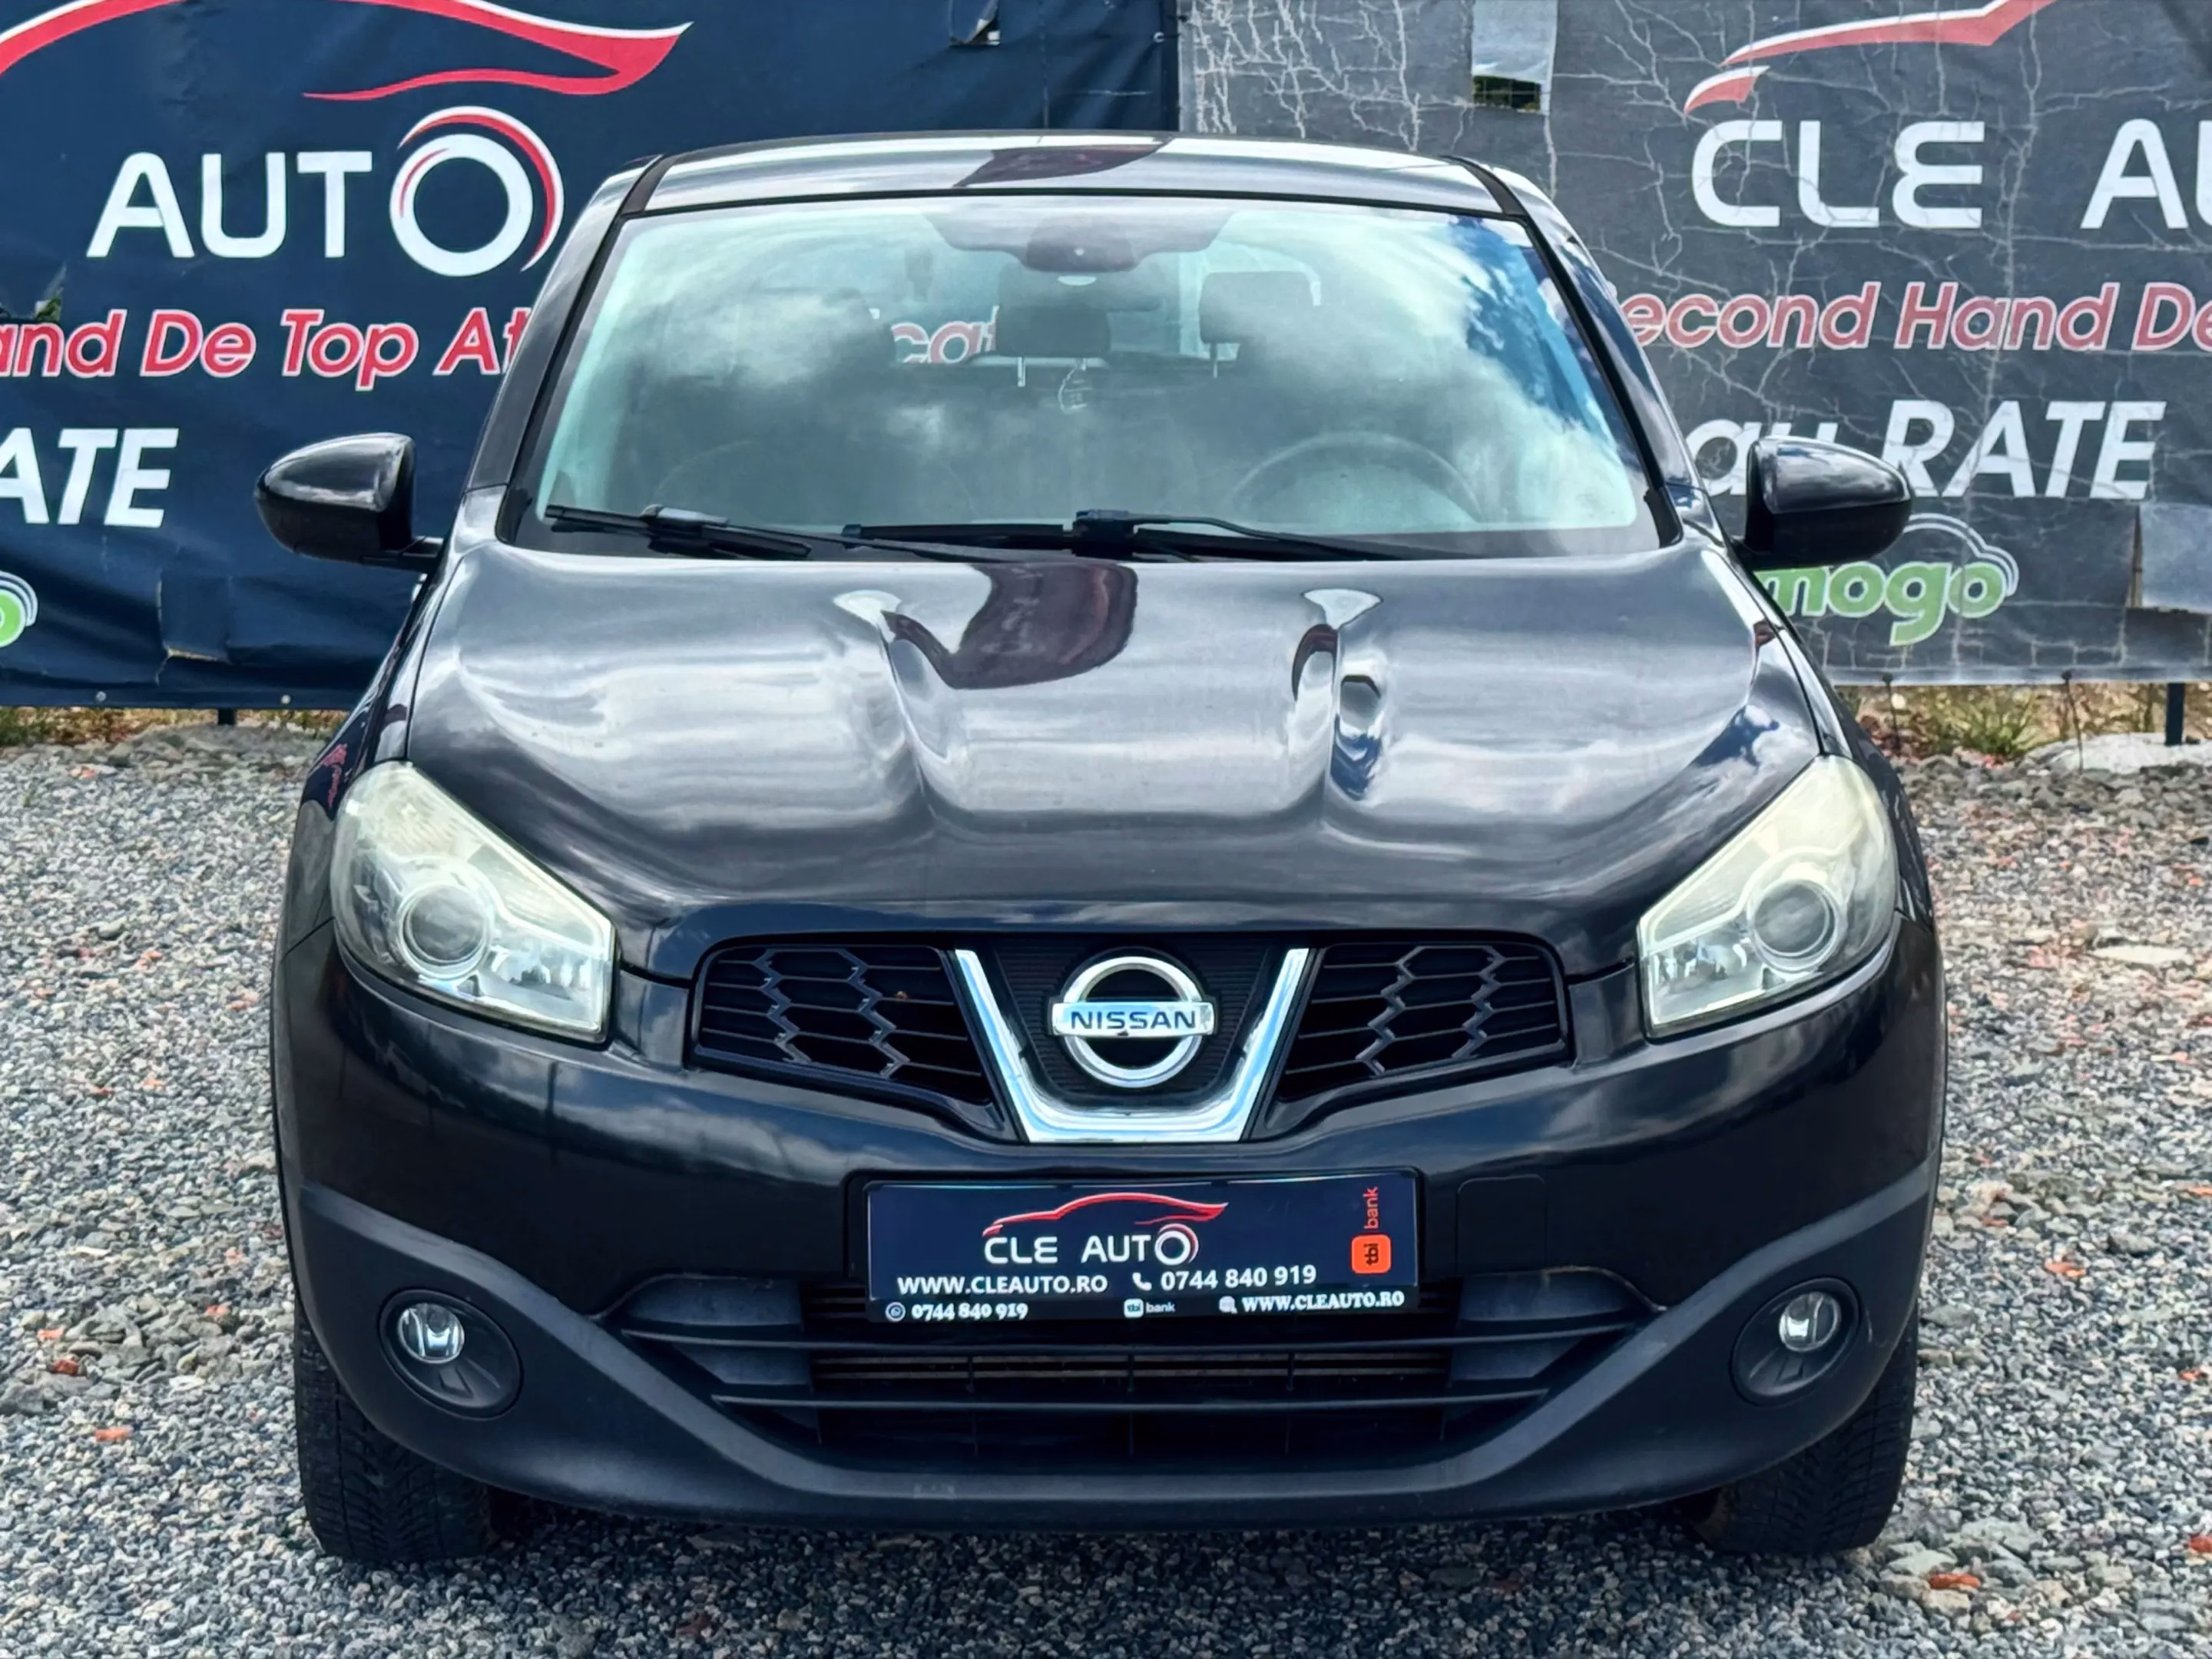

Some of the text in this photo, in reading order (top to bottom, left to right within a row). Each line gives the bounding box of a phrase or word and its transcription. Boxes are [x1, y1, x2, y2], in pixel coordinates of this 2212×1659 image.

[1691, 118, 2212, 229] CLE A
[86, 134, 534, 277] AUTO
[1606, 281, 1882, 350] econd
[1894, 282, 2121, 351] Hand
[139, 309, 257, 377] De
[282, 309, 419, 390] Top
[1881, 399, 2167, 500] RATE
[1753, 561, 2007, 647] mogo
[1071, 1011, 1196, 1030] NISSAN
[1363, 1186, 1379, 1230] bank
[984, 1230, 1192, 1266] CLE AUTO
[897, 1275, 1108, 1295] WWW.CLEAUTO.RO
[1161, 1265, 1317, 1291] 0744 840 919
[911, 1303, 1028, 1321] 0744 840 919
[1146, 1301, 1175, 1313] bank
[1242, 1290, 1405, 1313] WWW.CLEAUTO.RO
